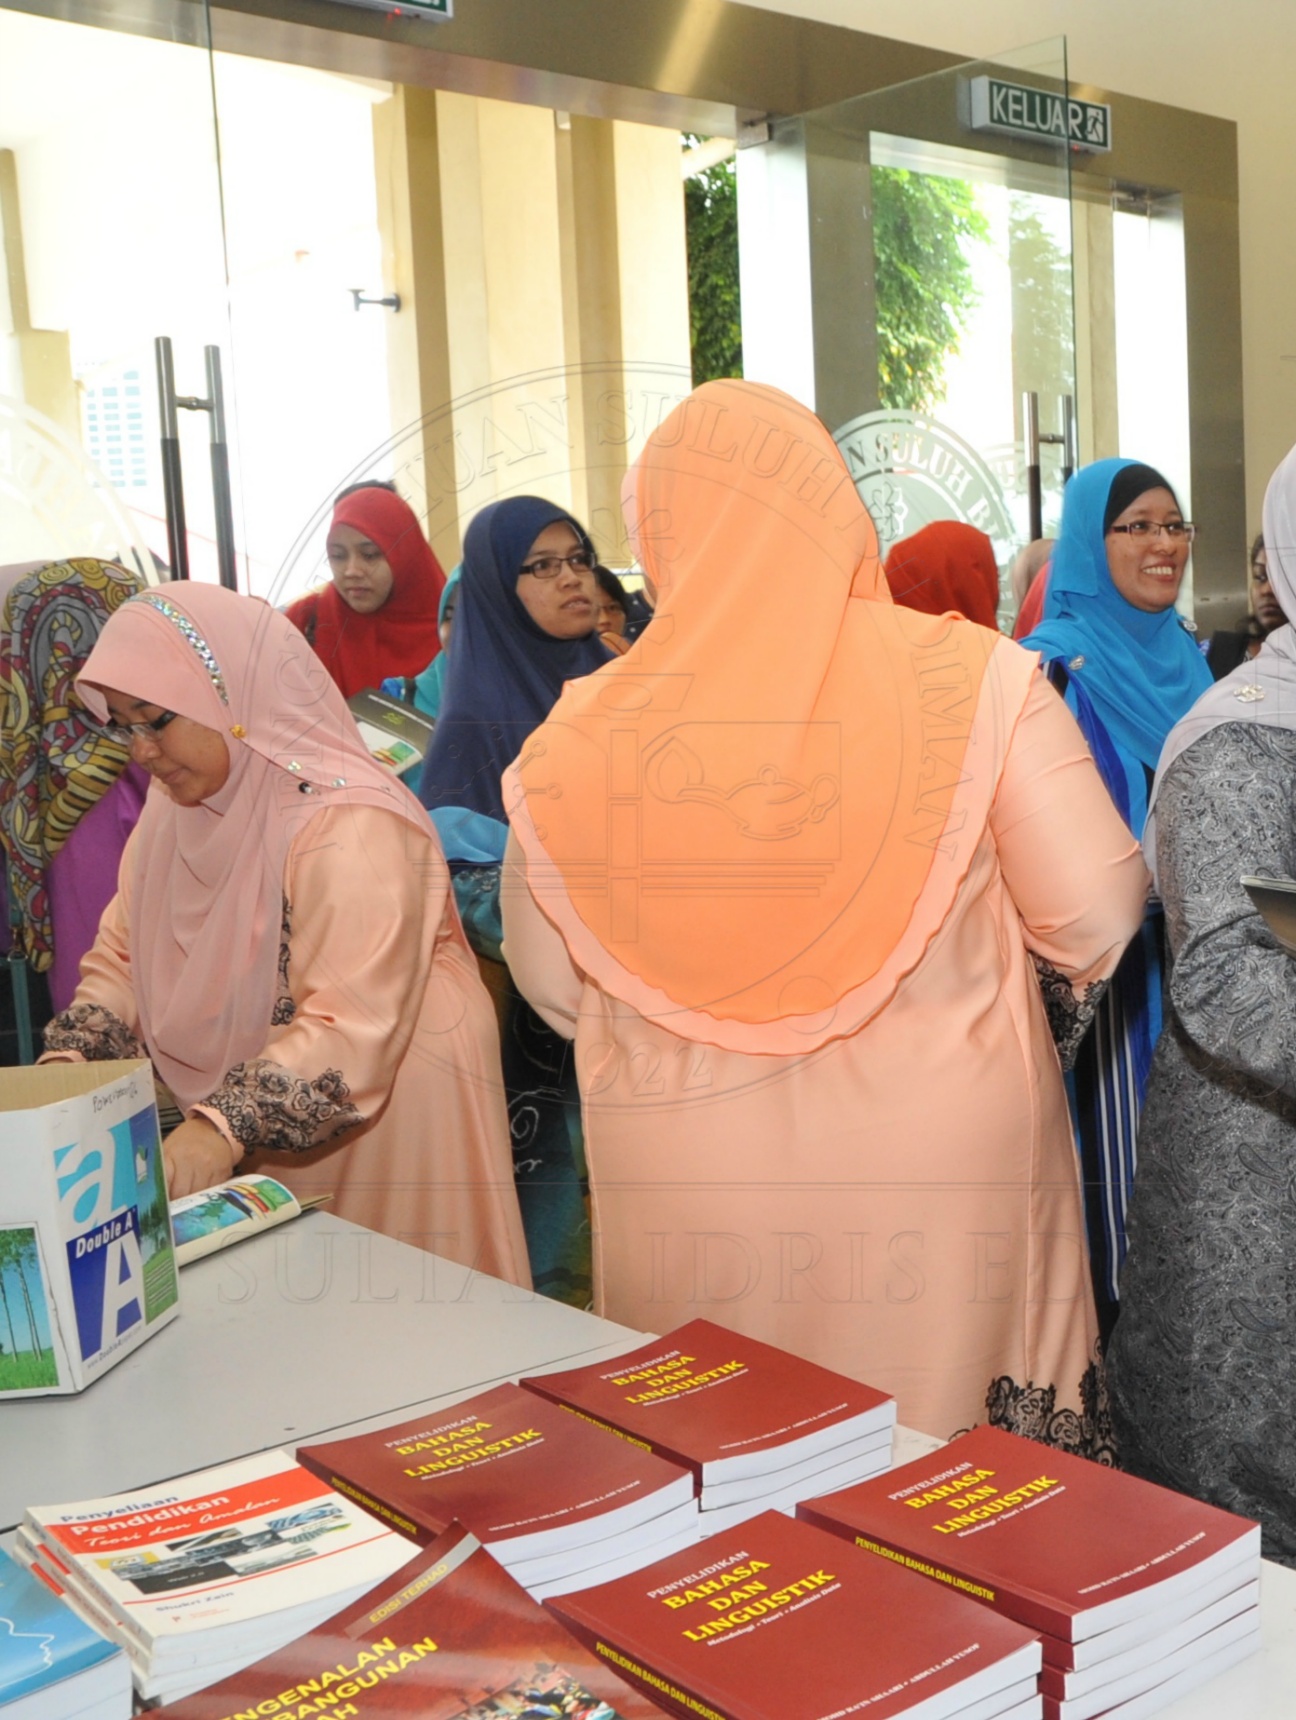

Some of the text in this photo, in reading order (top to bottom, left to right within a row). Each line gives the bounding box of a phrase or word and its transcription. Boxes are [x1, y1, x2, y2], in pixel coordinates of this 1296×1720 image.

[992, 84, 1083, 139] KELUAR
[75, 1211, 133, 1259] Double A
[600, 1350, 681, 1380] PENYELIDIKAN
[611, 1355, 697, 1386] BAHASA
[625, 1360, 746, 1404] LINGUISTIK
[646, 1368, 693, 1387] DAN
[384, 1415, 478, 1448] PENYELIDIKAN
[396, 1422, 493, 1456] BAHASA
[432, 1436, 485, 1457] DAN
[403, 1428, 543, 1478] LINGUISTIK
[888, 1461, 973, 1501] PENYELIDIKAN
[904, 1468, 996, 1509] BAHASA
[946, 1485, 998, 1510] DAN
[60, 1496, 178, 1523] Penyeliaan
[70, 1496, 230, 1536] Pendidikan
[84, 1497, 281, 1547] Teori dan Amalan
[932, 1474, 1059, 1534] LINGUISTIK
[647, 1550, 750, 1599] PENYELIDIKAN
[662, 1559, 771, 1610] BAHASA
[855, 1536, 995, 1601] PENYELIDIKAN BAHASA DAN LINGUISTIK
[369, 1564, 447, 1623] EDISI TERHAD
[682, 1569, 836, 1642] LINGUISTIK
[707, 1580, 769, 1611] DAN
[596, 1642, 642, 1677] PENYELIDIKAN
[642, 1670, 670, 1694] BAHASA
[670, 1686, 686, 1704] DAN
